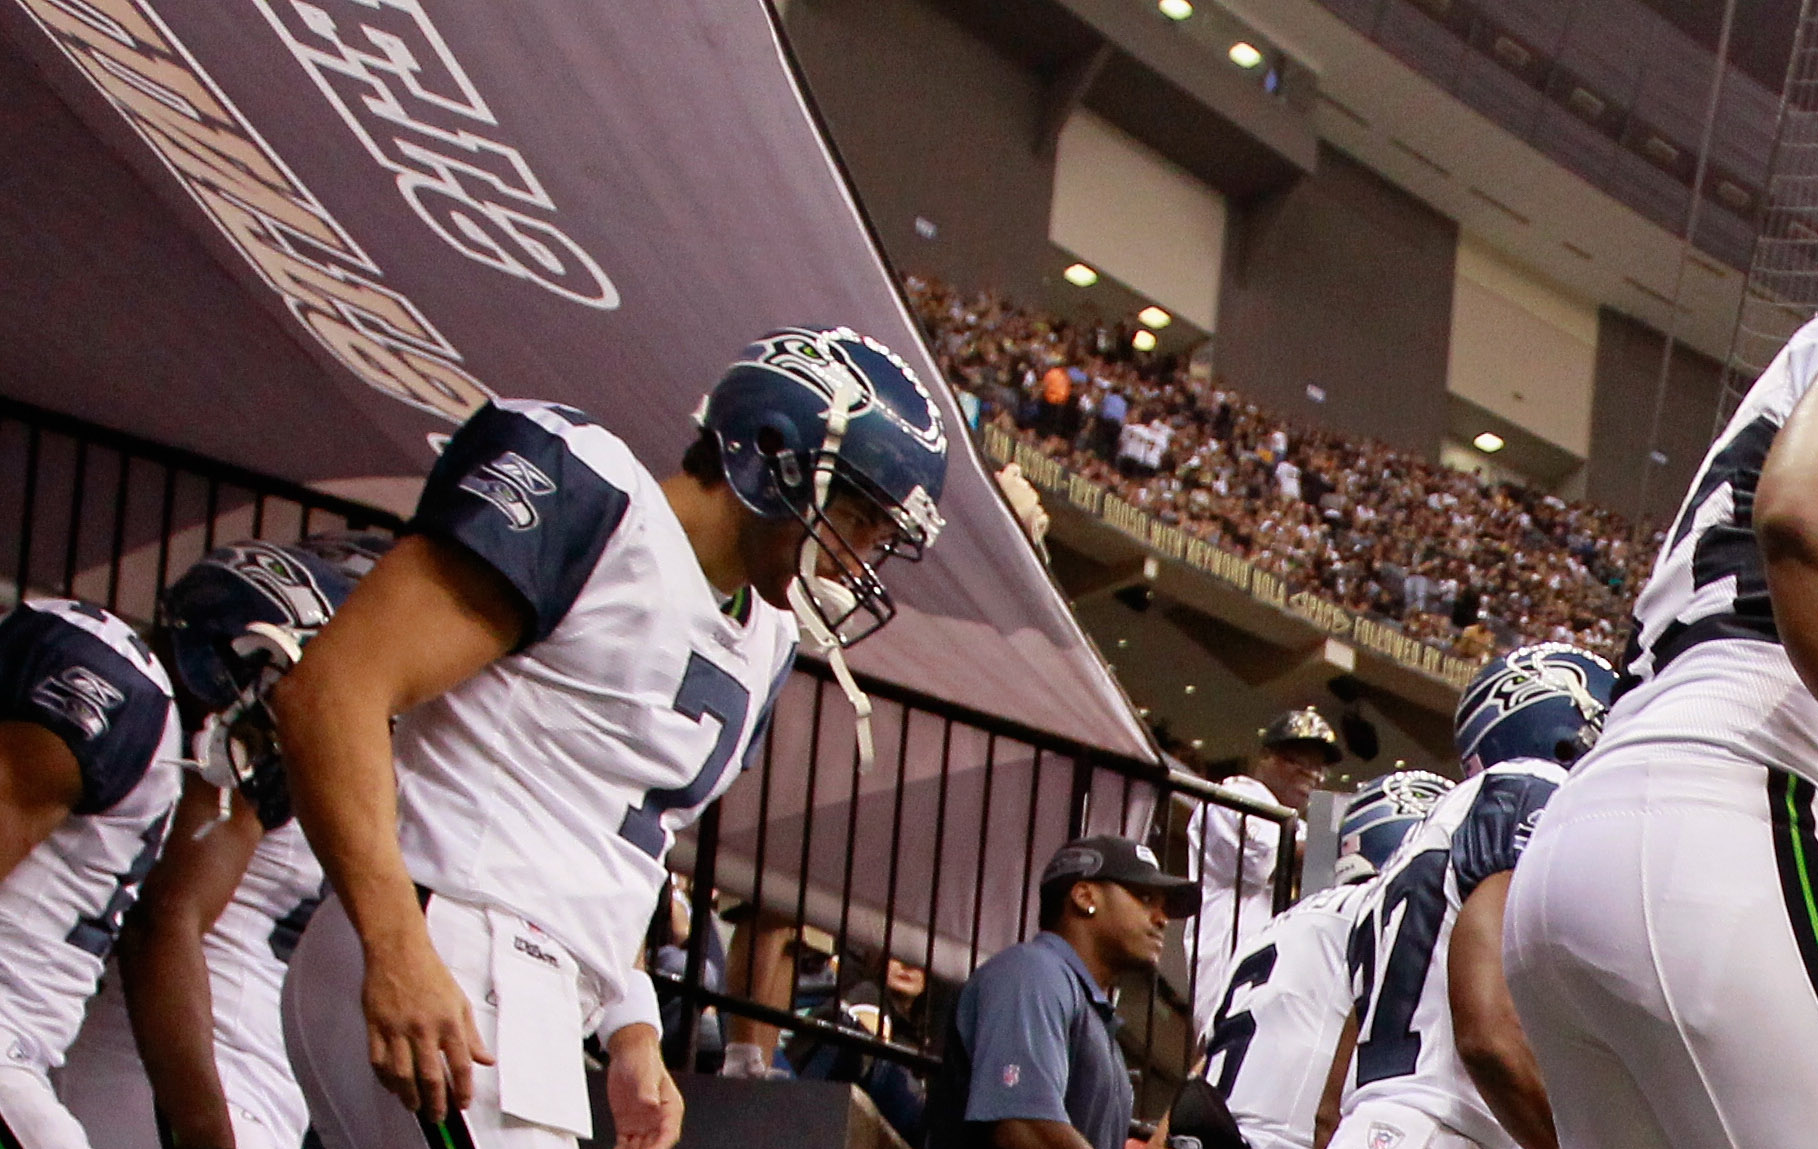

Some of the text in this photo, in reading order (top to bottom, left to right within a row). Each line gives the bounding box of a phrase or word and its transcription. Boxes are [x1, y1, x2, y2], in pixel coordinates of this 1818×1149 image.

[1187, 533, 1251, 591] KEYWORD
[1354, 615, 1423, 667] FOLLOWED
[618, 650, 750, 860] 7
